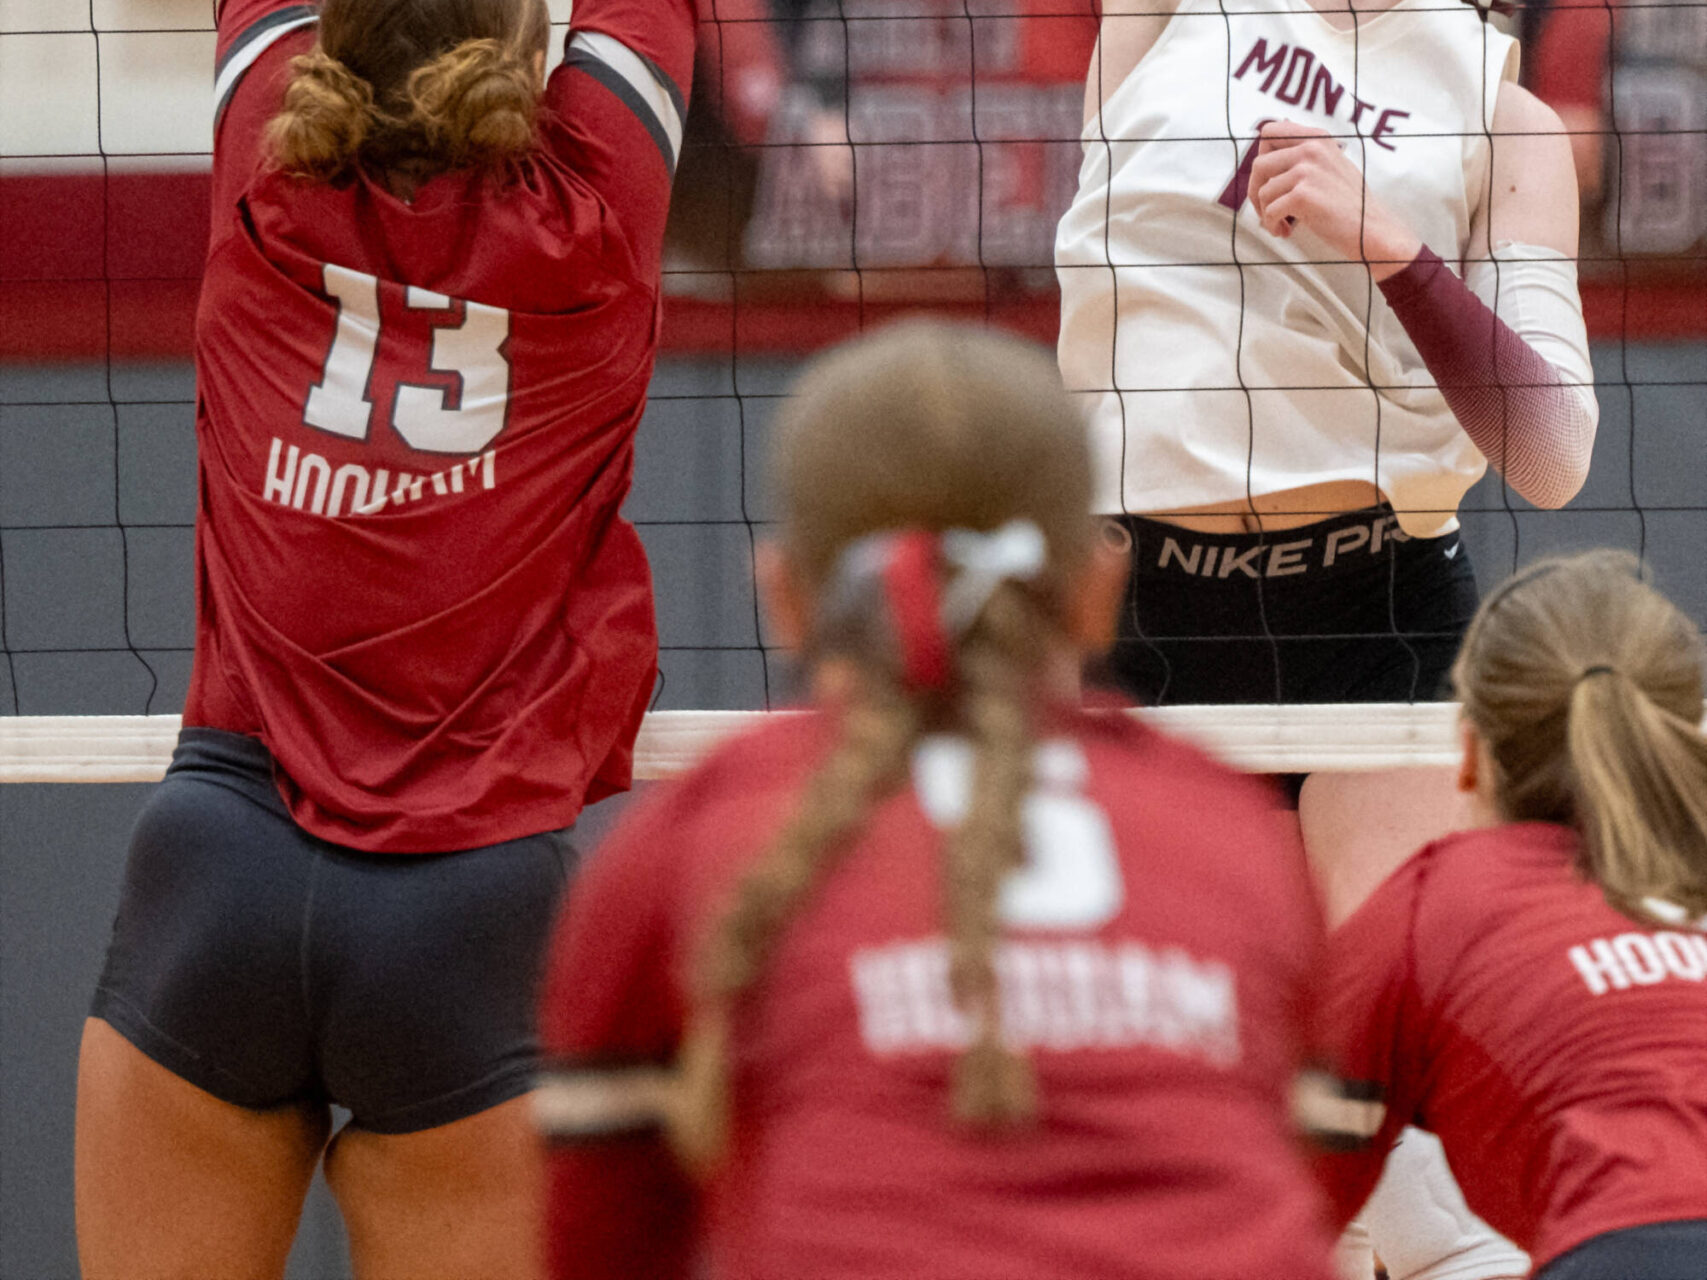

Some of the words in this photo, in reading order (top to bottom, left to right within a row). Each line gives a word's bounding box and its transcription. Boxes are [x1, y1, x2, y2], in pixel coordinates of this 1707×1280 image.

[1232, 37, 1412, 152] MONTE
[303, 263, 512, 455] 13
[1158, 536, 1314, 579] NIKE
[1322, 515, 1410, 567] PR
